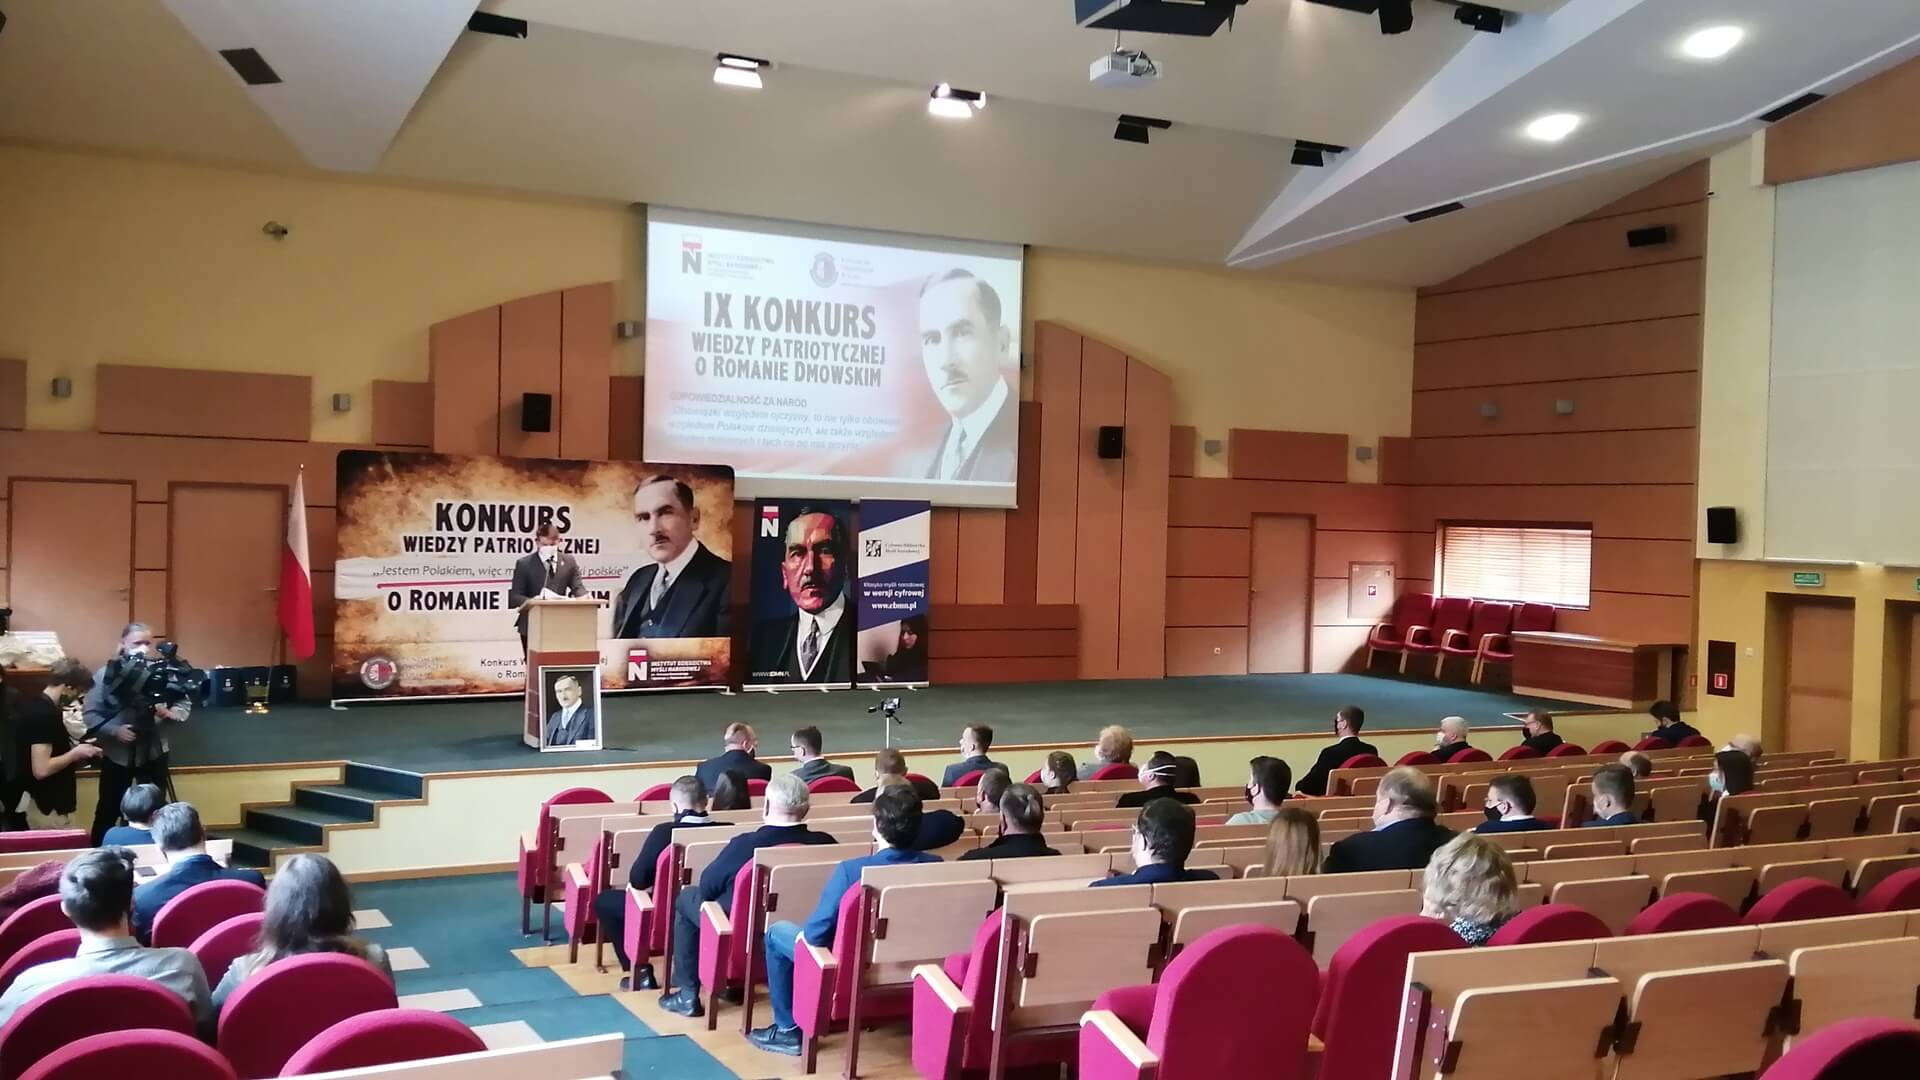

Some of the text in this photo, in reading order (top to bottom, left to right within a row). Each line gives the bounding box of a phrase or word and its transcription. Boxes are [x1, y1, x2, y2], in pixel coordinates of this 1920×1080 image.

[703, 291, 876, 340] IX KONKURS
[691, 331, 886, 366] WIEDZY PATRIOTYCZNEJ
[695, 355, 881, 388] O ROMANIE DMOWSKIM
[763, 395, 775, 406] ZA
[436, 502, 571, 533] KONKURS
[403, 536, 600, 554] WIEDZY PATRIOCZNEJ
[423, 566, 476, 577] Polakiem,
[478, 565, 502, 578] więc
[388, 591, 401, 611] O
[410, 589, 500, 611] ROMANIE
[872, 589, 893, 598] wersji
[894, 589, 925, 598] cyfrowej
[480, 657, 518, 667] Konkurs
